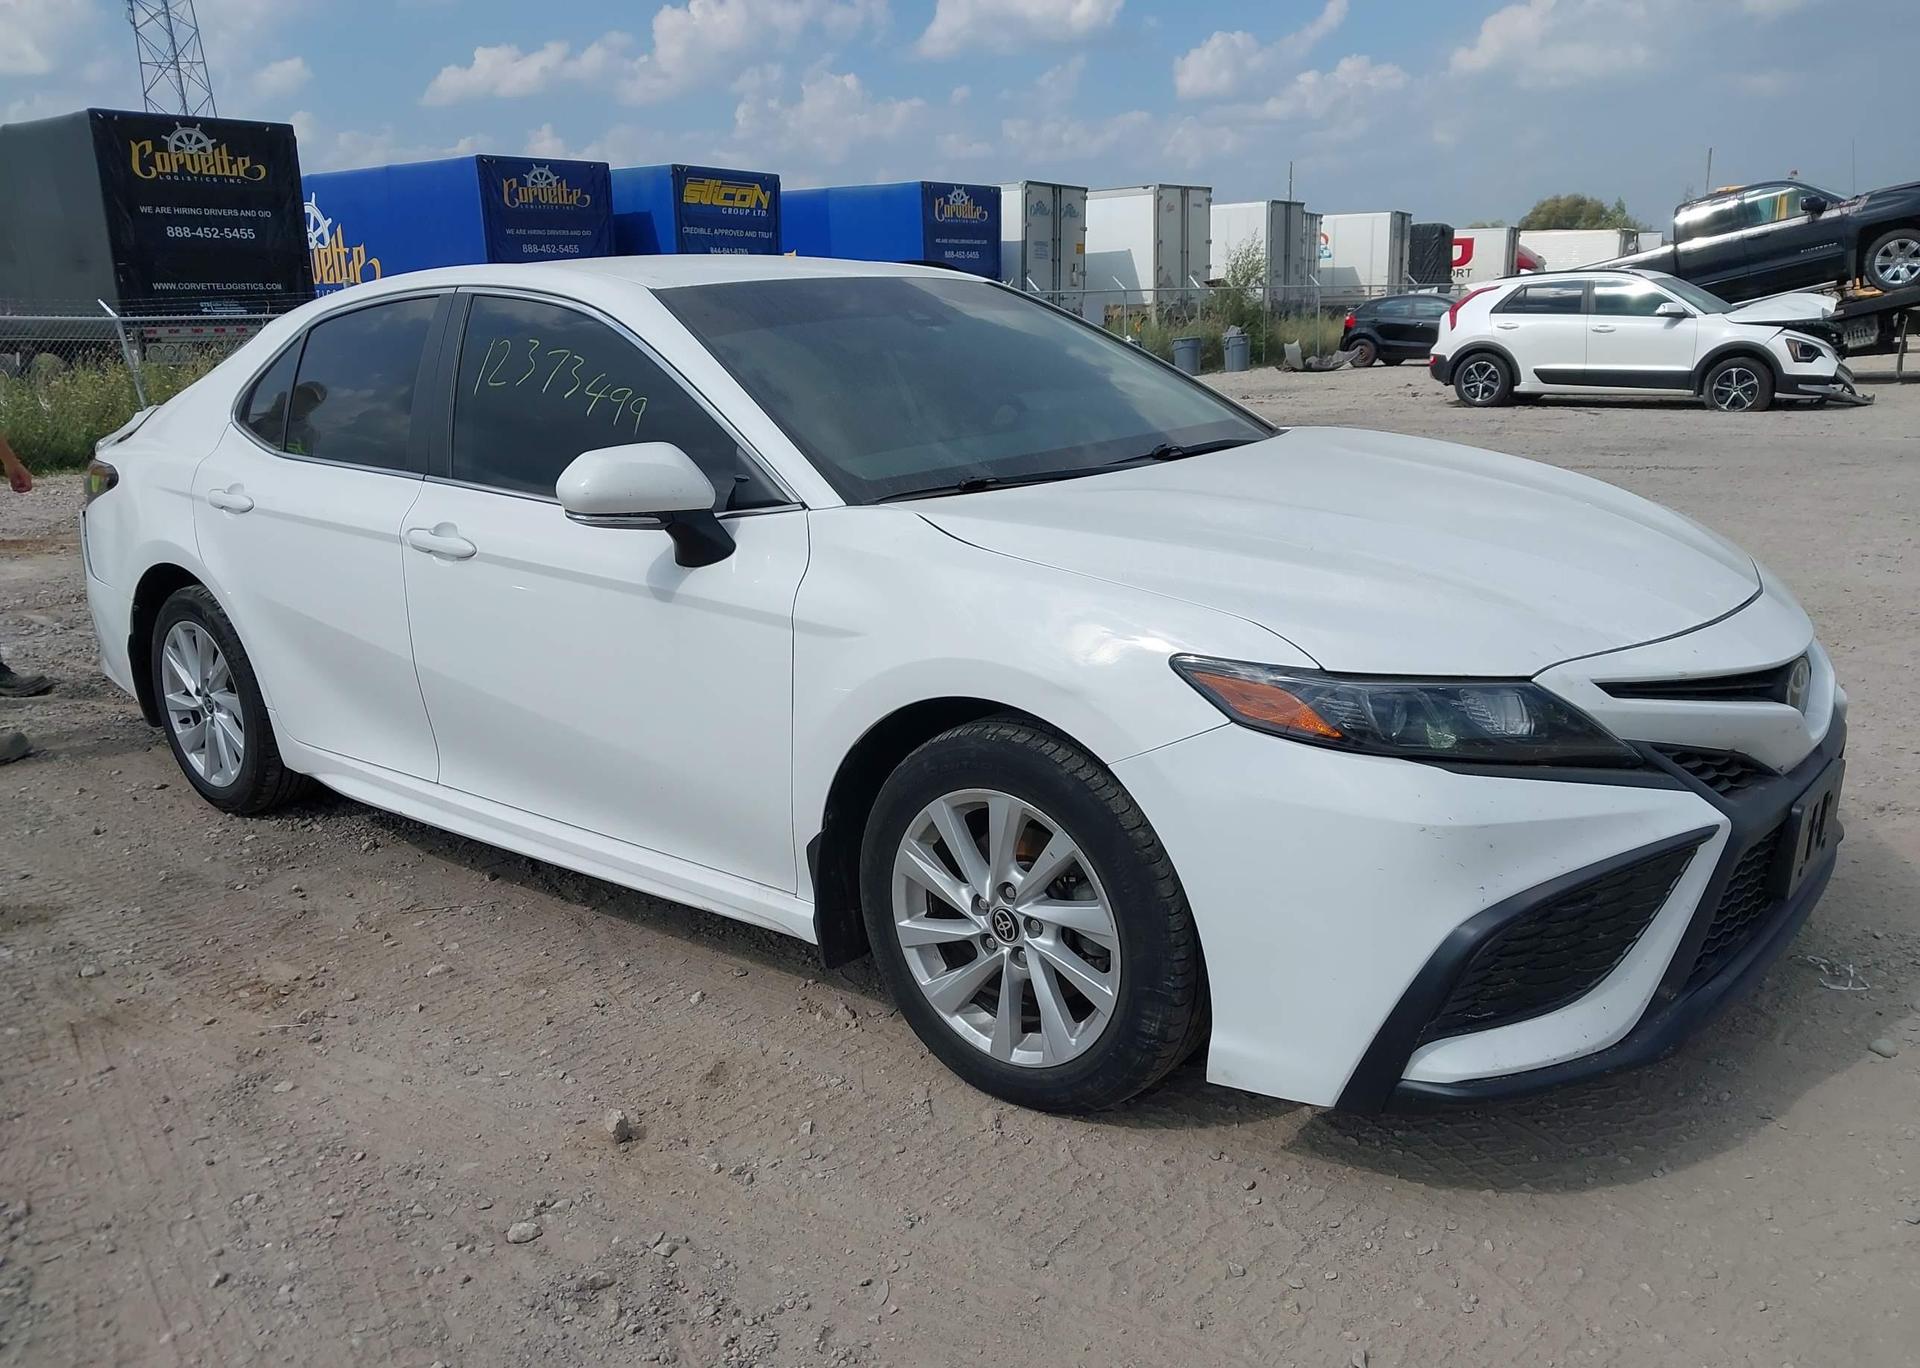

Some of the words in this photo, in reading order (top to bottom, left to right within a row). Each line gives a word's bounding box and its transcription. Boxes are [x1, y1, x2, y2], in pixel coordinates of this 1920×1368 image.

[130, 139, 266, 181] Corvette
[159, 174, 218, 183] LOGISTICS
[503, 177, 591, 209] Corvette
[139, 205, 153, 214] WE
[155, 206, 172, 215] ARE
[174, 207, 203, 215] HIRING
[204, 208, 239, 217] DRIVERS
[240, 209, 257, 217] AND
[721, 208, 750, 216] GROUP
[753, 209, 769, 217] LTD.
[166, 225, 256, 240] 888-452-5455
[473, 337, 648, 436] 12373499
